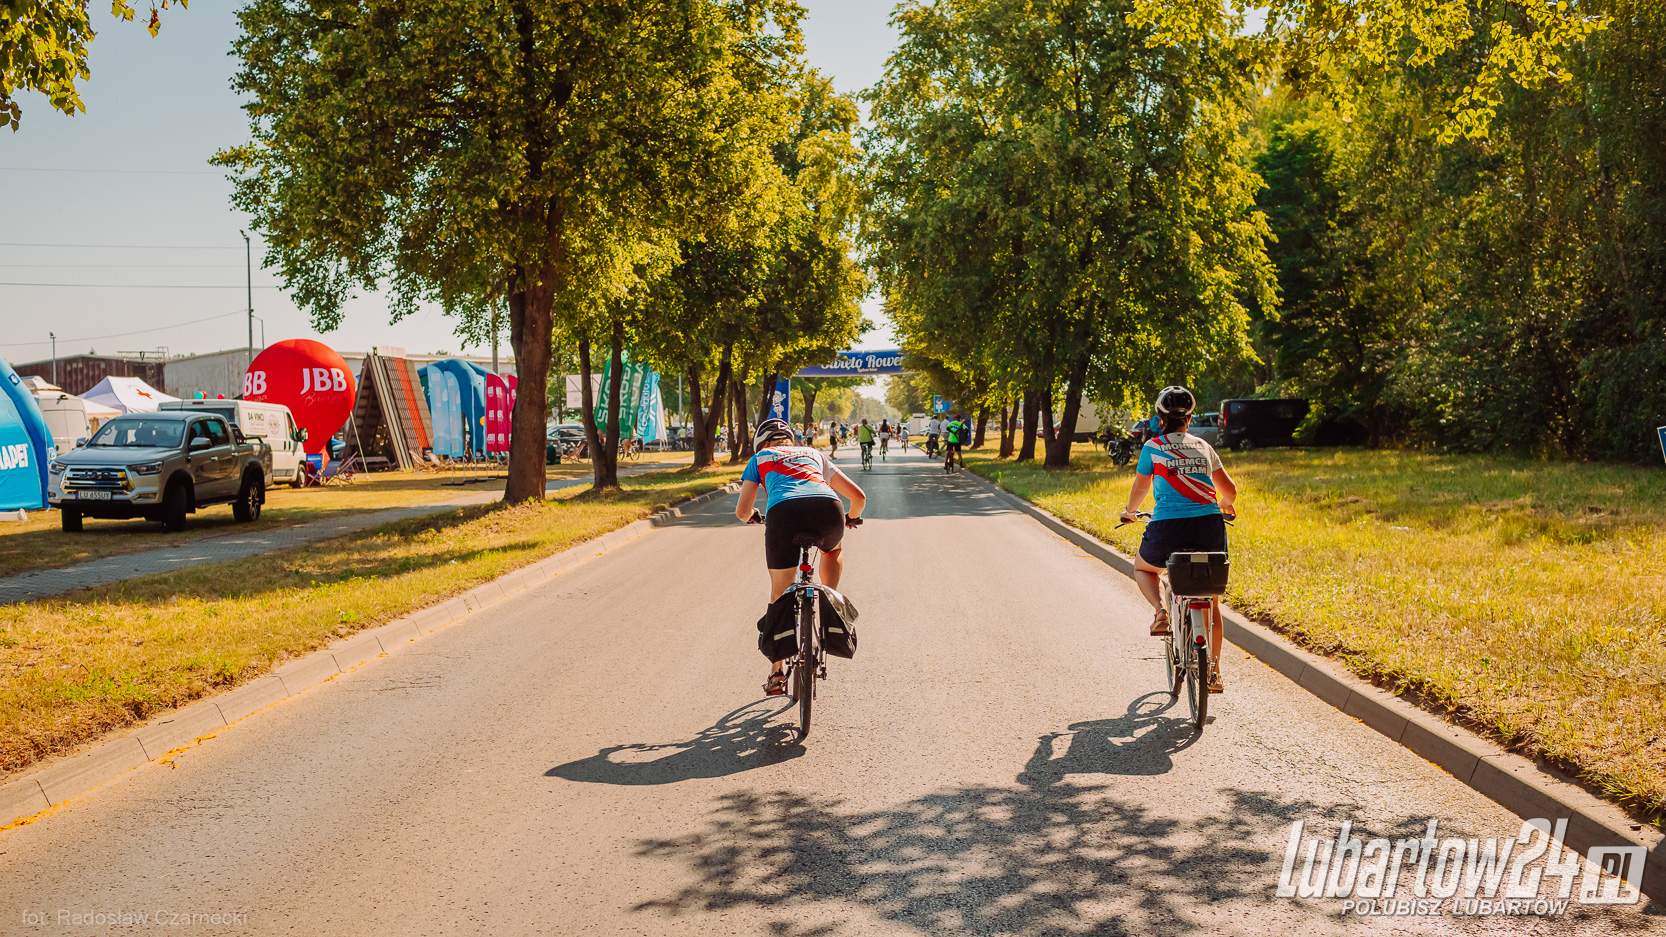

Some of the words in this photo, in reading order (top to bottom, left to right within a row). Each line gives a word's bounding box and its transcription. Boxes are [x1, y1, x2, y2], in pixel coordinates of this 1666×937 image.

[300, 367, 347, 395] JBB
[1168, 458, 1206, 467] NIEMCE
[1179, 466, 1206, 475] TEAM
